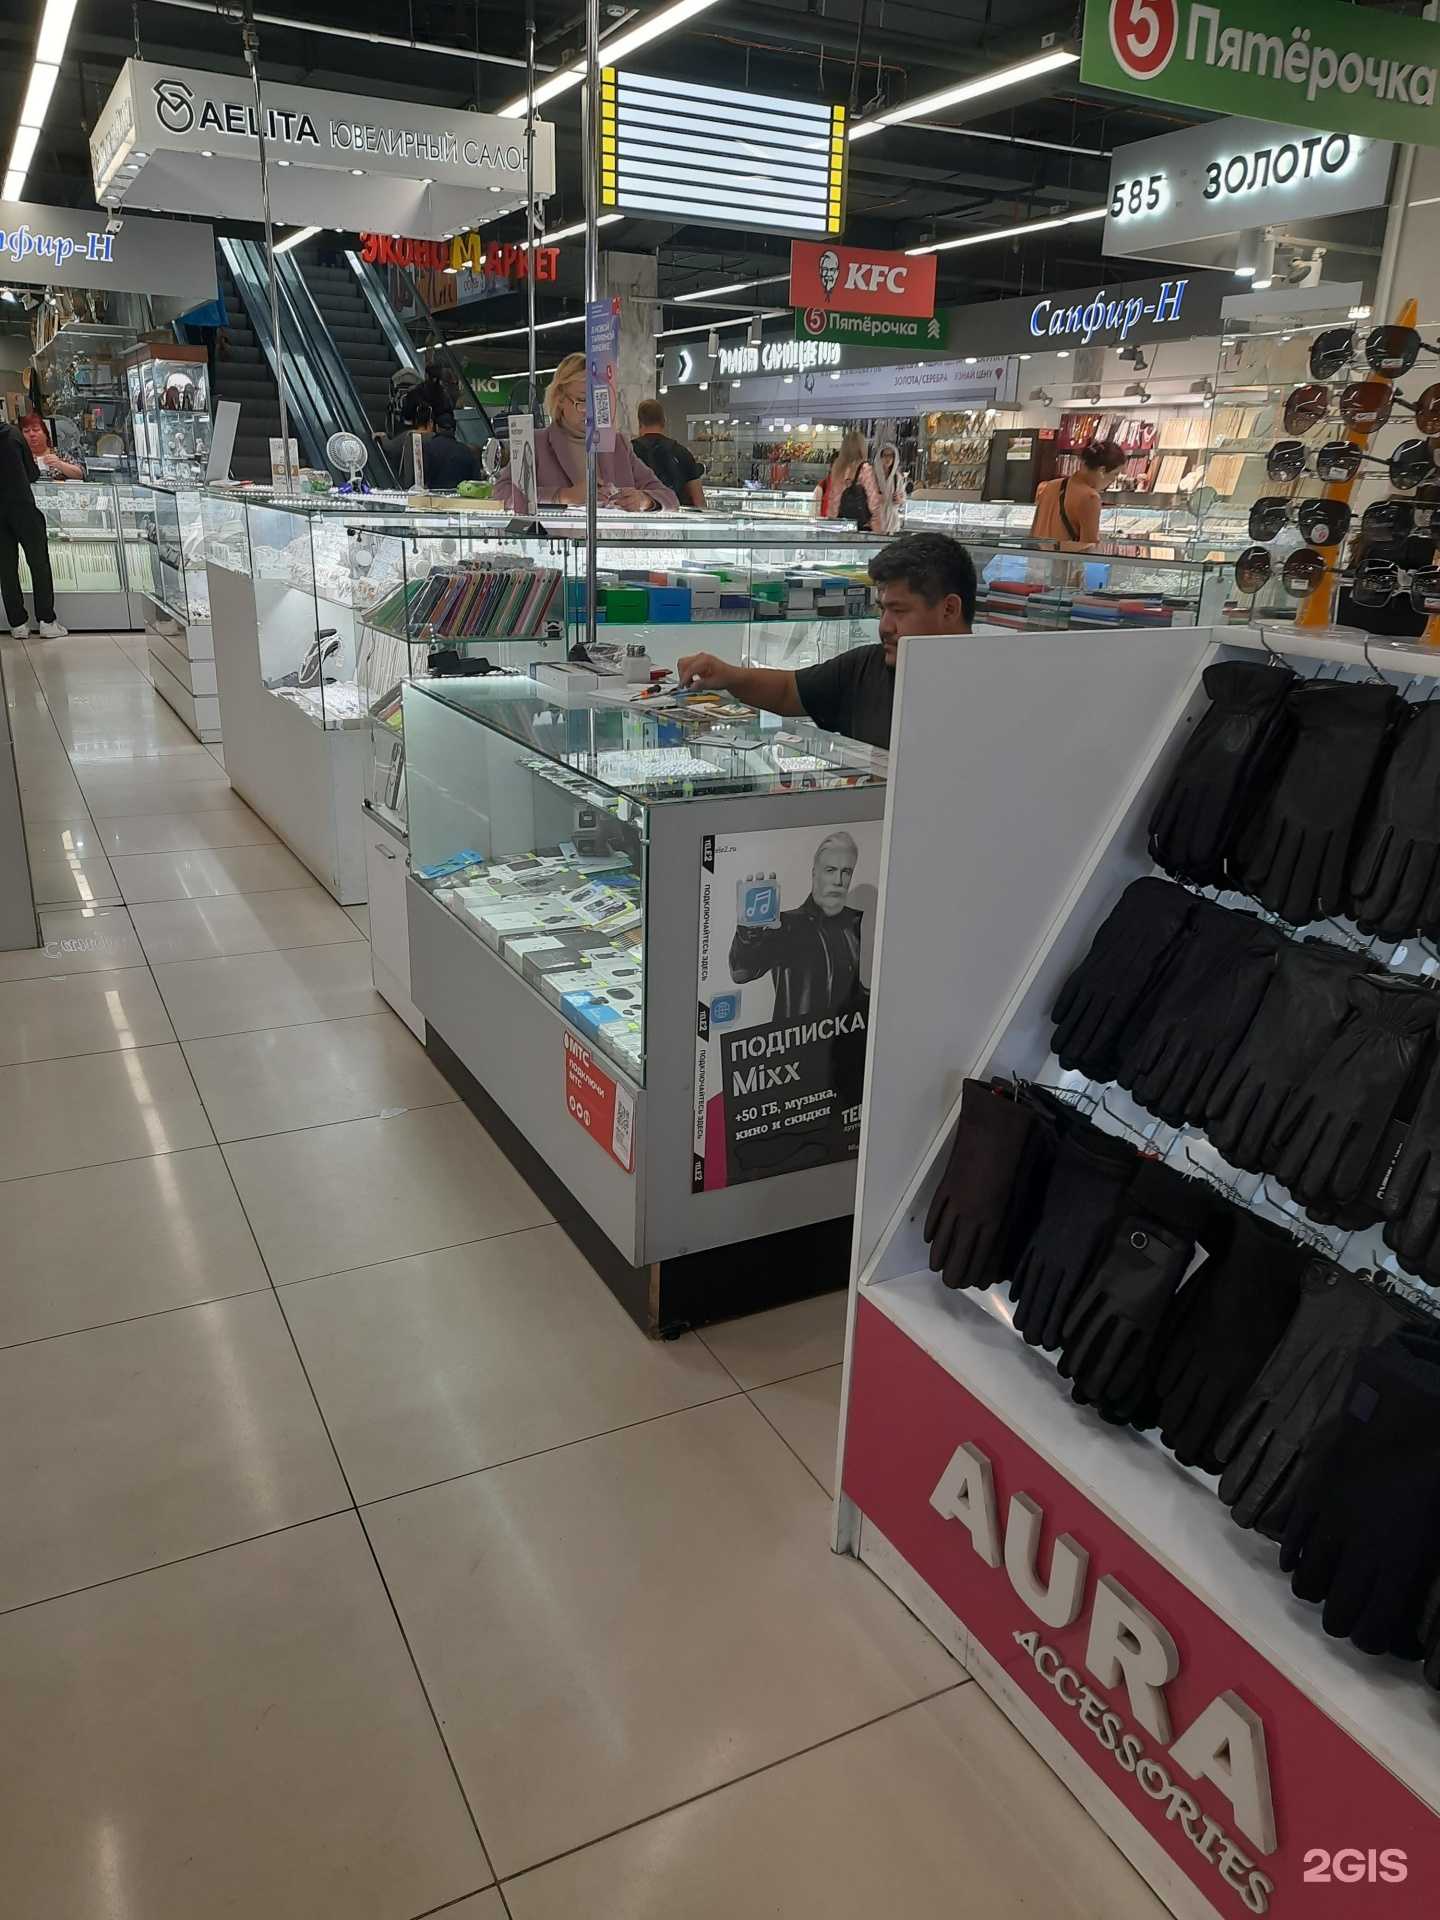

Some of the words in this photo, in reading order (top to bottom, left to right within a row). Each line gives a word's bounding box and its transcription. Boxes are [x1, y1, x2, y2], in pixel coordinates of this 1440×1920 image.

[1126, 0, 1160, 58] 5
[1185, 3, 1438, 105] Пятёрочка
[199, 100, 320, 145] AELITA
[330, 120, 458, 164] ЮВЕЛИРНЫЙ
[1111, 174, 1165, 218] 585
[1203, 133, 1351, 200] ЗОЛОТО
[0, 225, 115, 266] фир-Н
[845, 263, 908, 293] KFC
[829, 313, 917, 336] Пятёрочка
[1030, 280, 1189, 344] Сапфир-Н
[701, 956, 709, 982] ЗДЕСЬ
[569, 1037, 588, 1067] МТС
[731, 1011, 866, 1062] ПОДПИСКА
[733, 1062, 801, 1097] Mixx
[735, 1108, 758, 1123] +50
[761, 1102, 781, 1116] ГБ,
[785, 1089, 837, 1110] музыка,
[735, 1124, 768, 1141] кино
[772, 1120, 781, 1131] и
[785, 1106, 832, 1127] скидки
[929, 1441, 1277, 1857] AURA
[1012, 1630, 1275, 1915] ACCESSORIES
